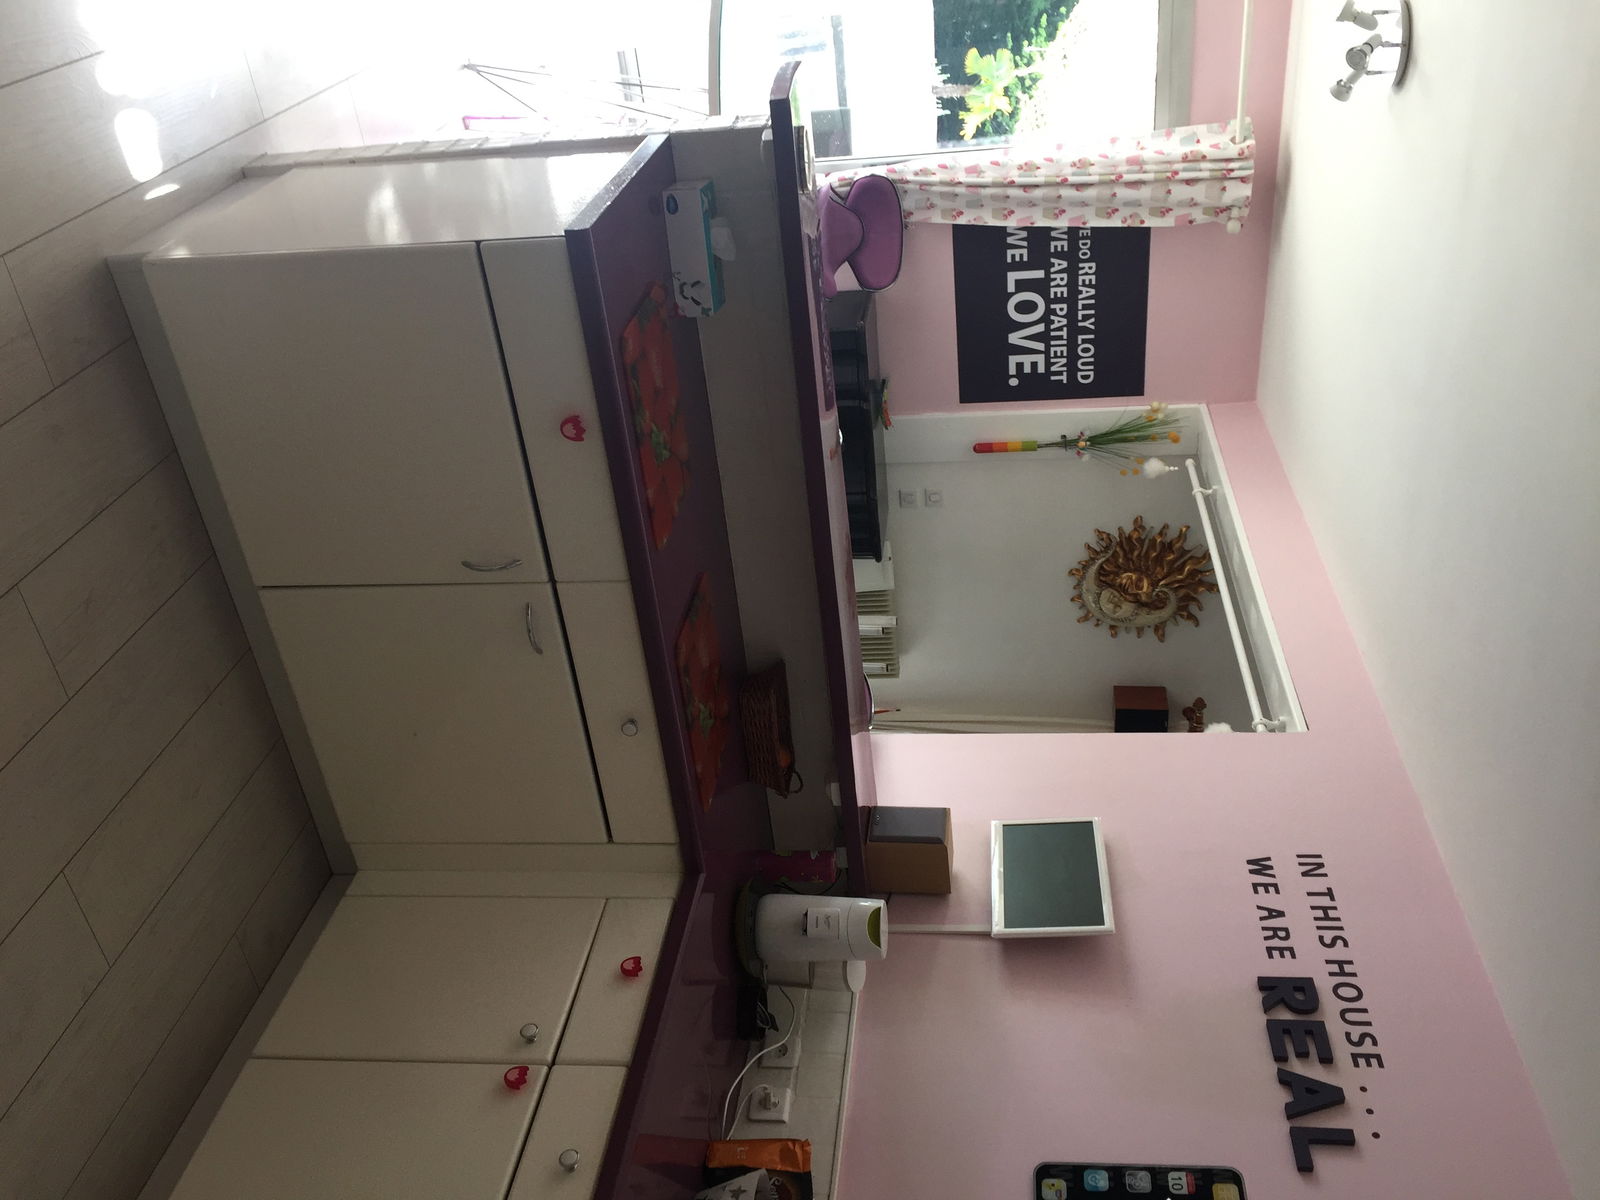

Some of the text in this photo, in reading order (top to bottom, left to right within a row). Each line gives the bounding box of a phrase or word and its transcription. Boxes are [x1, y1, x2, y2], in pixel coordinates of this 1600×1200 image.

[1078, 239, 1091, 259] DO
[1050, 257, 1068, 299] ARE
[1077, 262, 1097, 330] REALLY
[1006, 227, 1046, 387] WE LOVE.
[1050, 303, 1068, 384] PATIENT
[1077, 334, 1096, 385] LOUD
[1295, 854, 1329, 879] IN
[1306, 886, 1349, 949] THIS
[1246, 856, 1357, 1174] WE ARE REAL
[1170, 1176, 1184, 1191] 10
